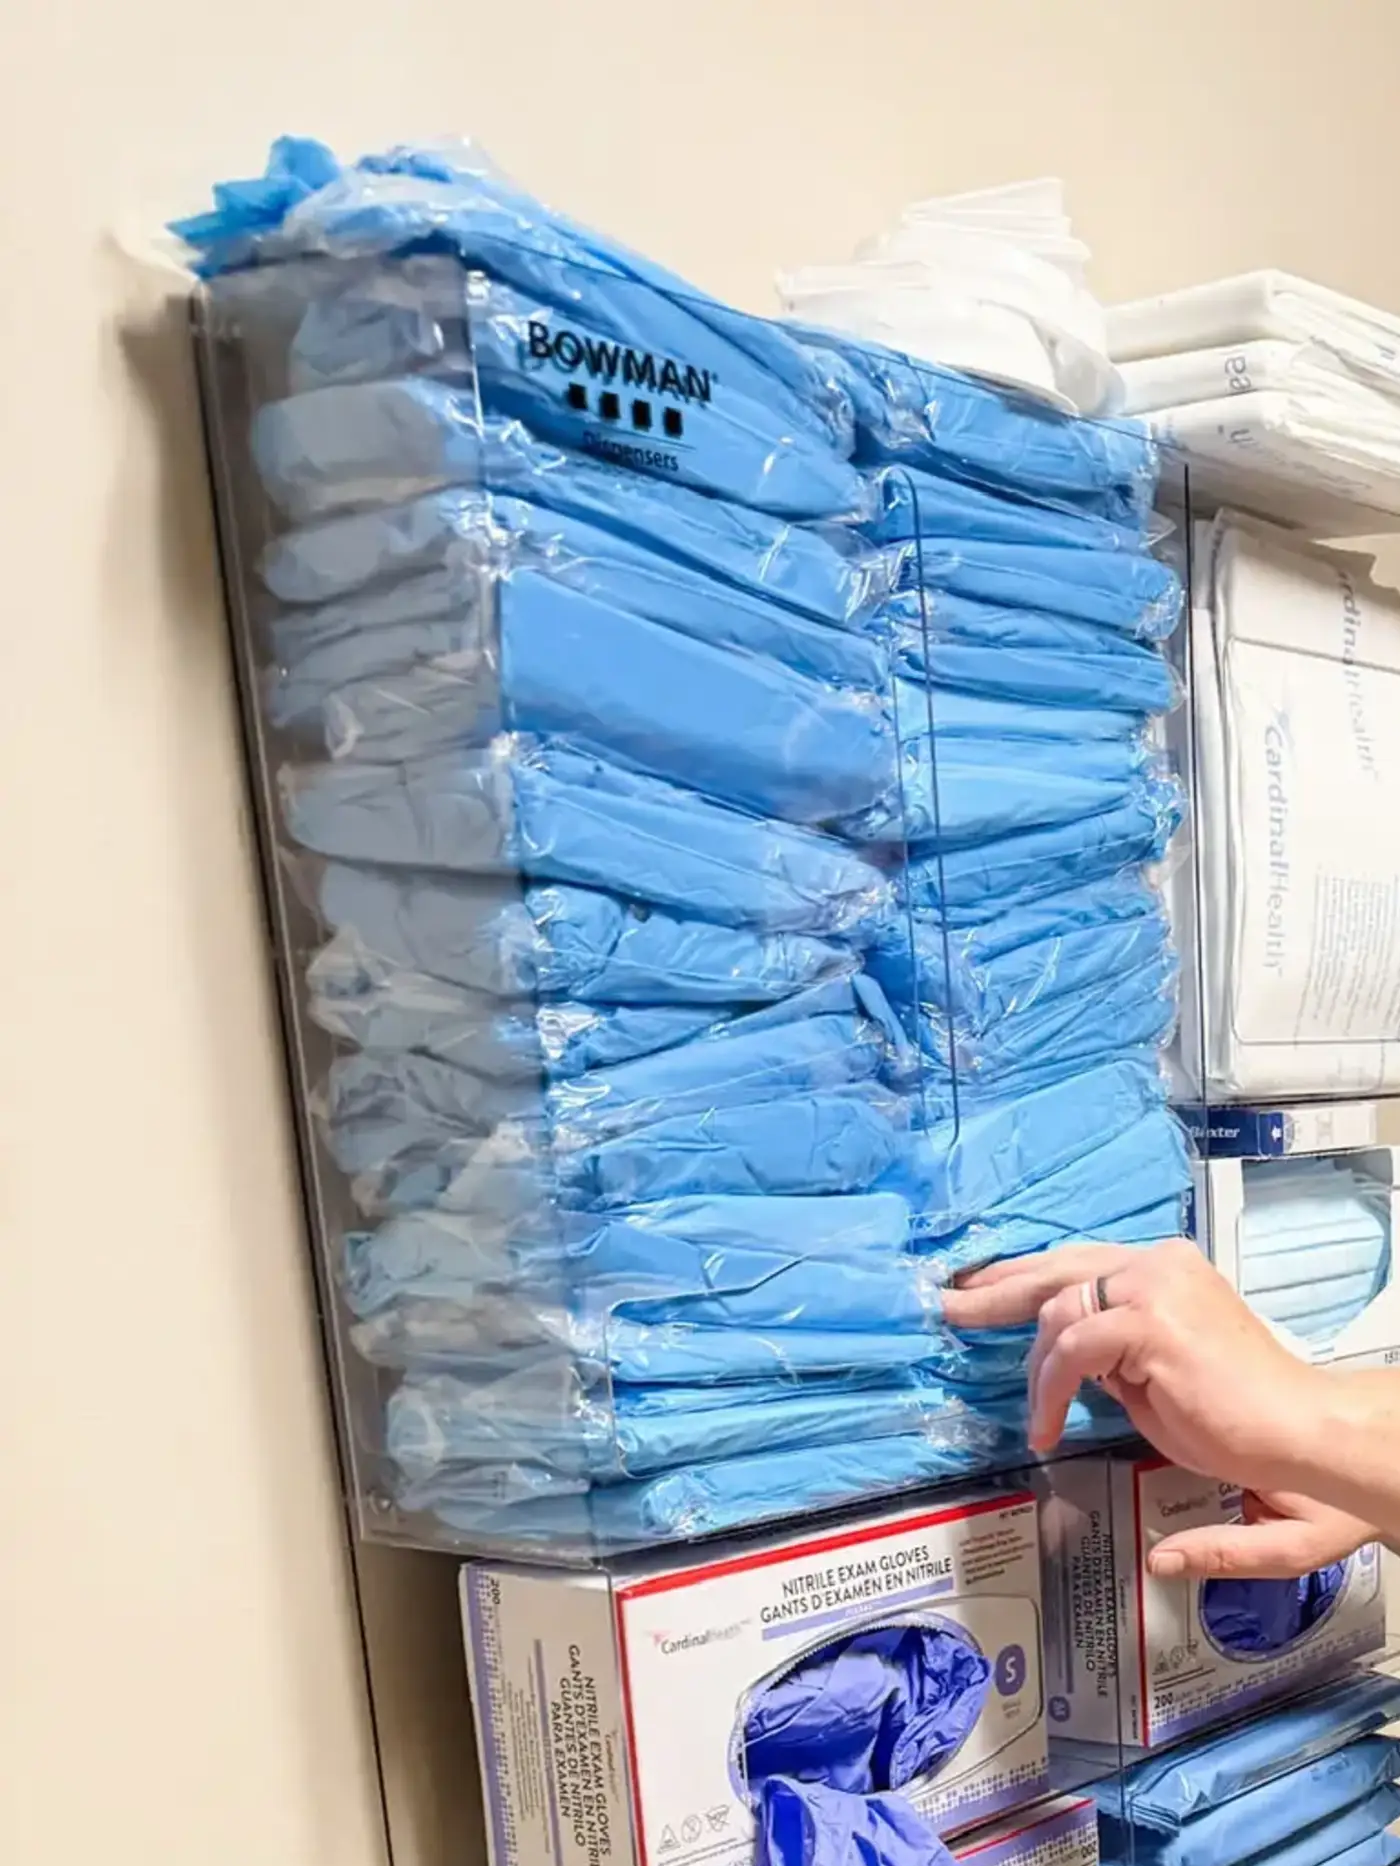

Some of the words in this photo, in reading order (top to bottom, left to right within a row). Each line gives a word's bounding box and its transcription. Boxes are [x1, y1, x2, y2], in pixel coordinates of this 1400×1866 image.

[528, 319, 711, 402] BOWMAN
[1191, 1126, 1240, 1139] Baxter
[1088, 1510, 1101, 1553] GANTS
[781, 1569, 835, 1598] NITRILE
[837, 1557, 877, 1583] EXAM
[878, 1545, 929, 1572] GLOVES
[1071, 1556, 1080, 1590] PARA
[1080, 1535, 1092, 1597] GUANTES
[1101, 1533, 1113, 1581] NITRILE
[489, 1578, 500, 1604] 200
[759, 1597, 808, 1623] GANTS
[884, 1570, 903, 1589] EN
[904, 1557, 953, 1583] NITRILE
[1083, 1600, 1092, 1615] DE
[1072, 1593, 1083, 1648] EXAMEN
[1095, 1629, 1104, 1645] EN
[1005, 1655, 1017, 1684] S
[1083, 1620, 1095, 1671] NITRILO
[1096, 1648, 1107, 1697] NITRILE
[549, 1701, 563, 1743] PARA
[559, 1677, 577, 1753] GUANTES
[582, 1676, 599, 1736] NITRILE
[1154, 1692, 1173, 1709] 200
[567, 1644, 583, 1699] GANTS
[582, 1794, 595, 1817] EN
[554, 1747, 570, 1817] EXAMEN
[567, 1757, 579, 1778] DE
[588, 1740, 604, 1788] EXAM
[569, 1781, 585, 1846] NITRILO
[594, 1792, 610, 1855] GLOVES
